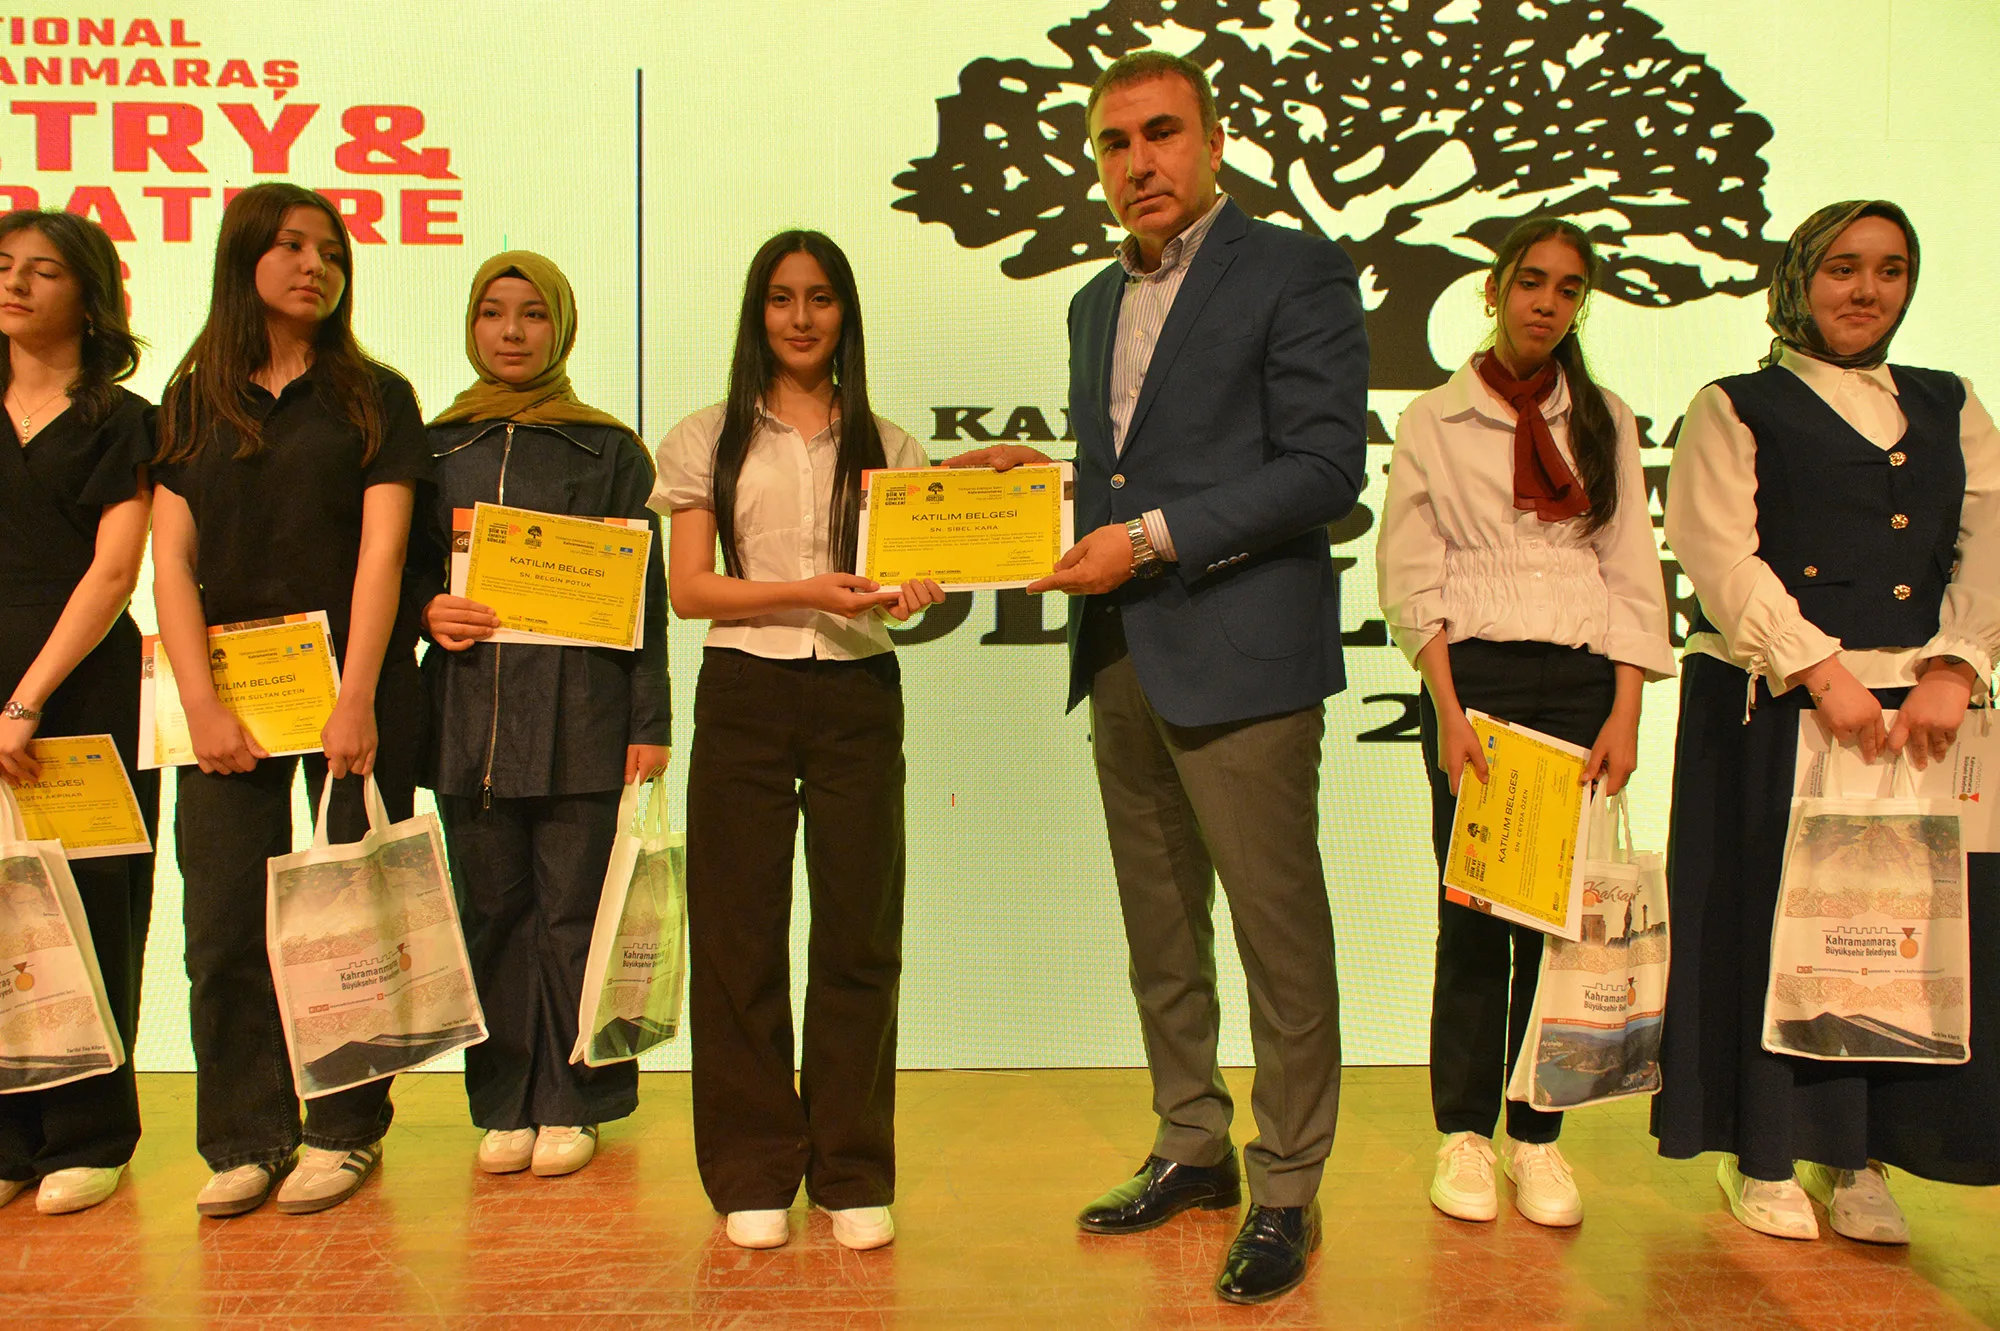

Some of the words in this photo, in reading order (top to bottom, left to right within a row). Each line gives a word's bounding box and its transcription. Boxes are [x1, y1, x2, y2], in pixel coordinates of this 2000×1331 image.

[0, 17, 201, 47] IONAL
[912, 512, 962, 521] KATILIM
[966, 509, 1018, 520] BELGESİ
[510, 556, 555, 570] KATILIM
[558, 563, 605, 578] BELGESİ
[535, 574, 563, 583] BELGİN
[565, 579, 592, 588] POTUK
[250, 674, 296, 688] BELGESİ
[248, 692, 279, 700] SULTAN
[281, 688, 305, 697] ÇETİN
[34, 778, 85, 789] BELGESİ
[1519, 789, 1529, 810] ÖZEN
[1498, 817, 1511, 863] KATILIM
[1505, 768, 1519, 815] BELGESİ
[1517, 812, 1525, 837] CEYDA
[1825, 934, 1897, 948] Kahramanmaraş
[1825, 946, 1864, 957] Büyükşehir
[1866, 948, 1898, 958] Belediyesi
[341, 978, 377, 991] Büyükşehir
